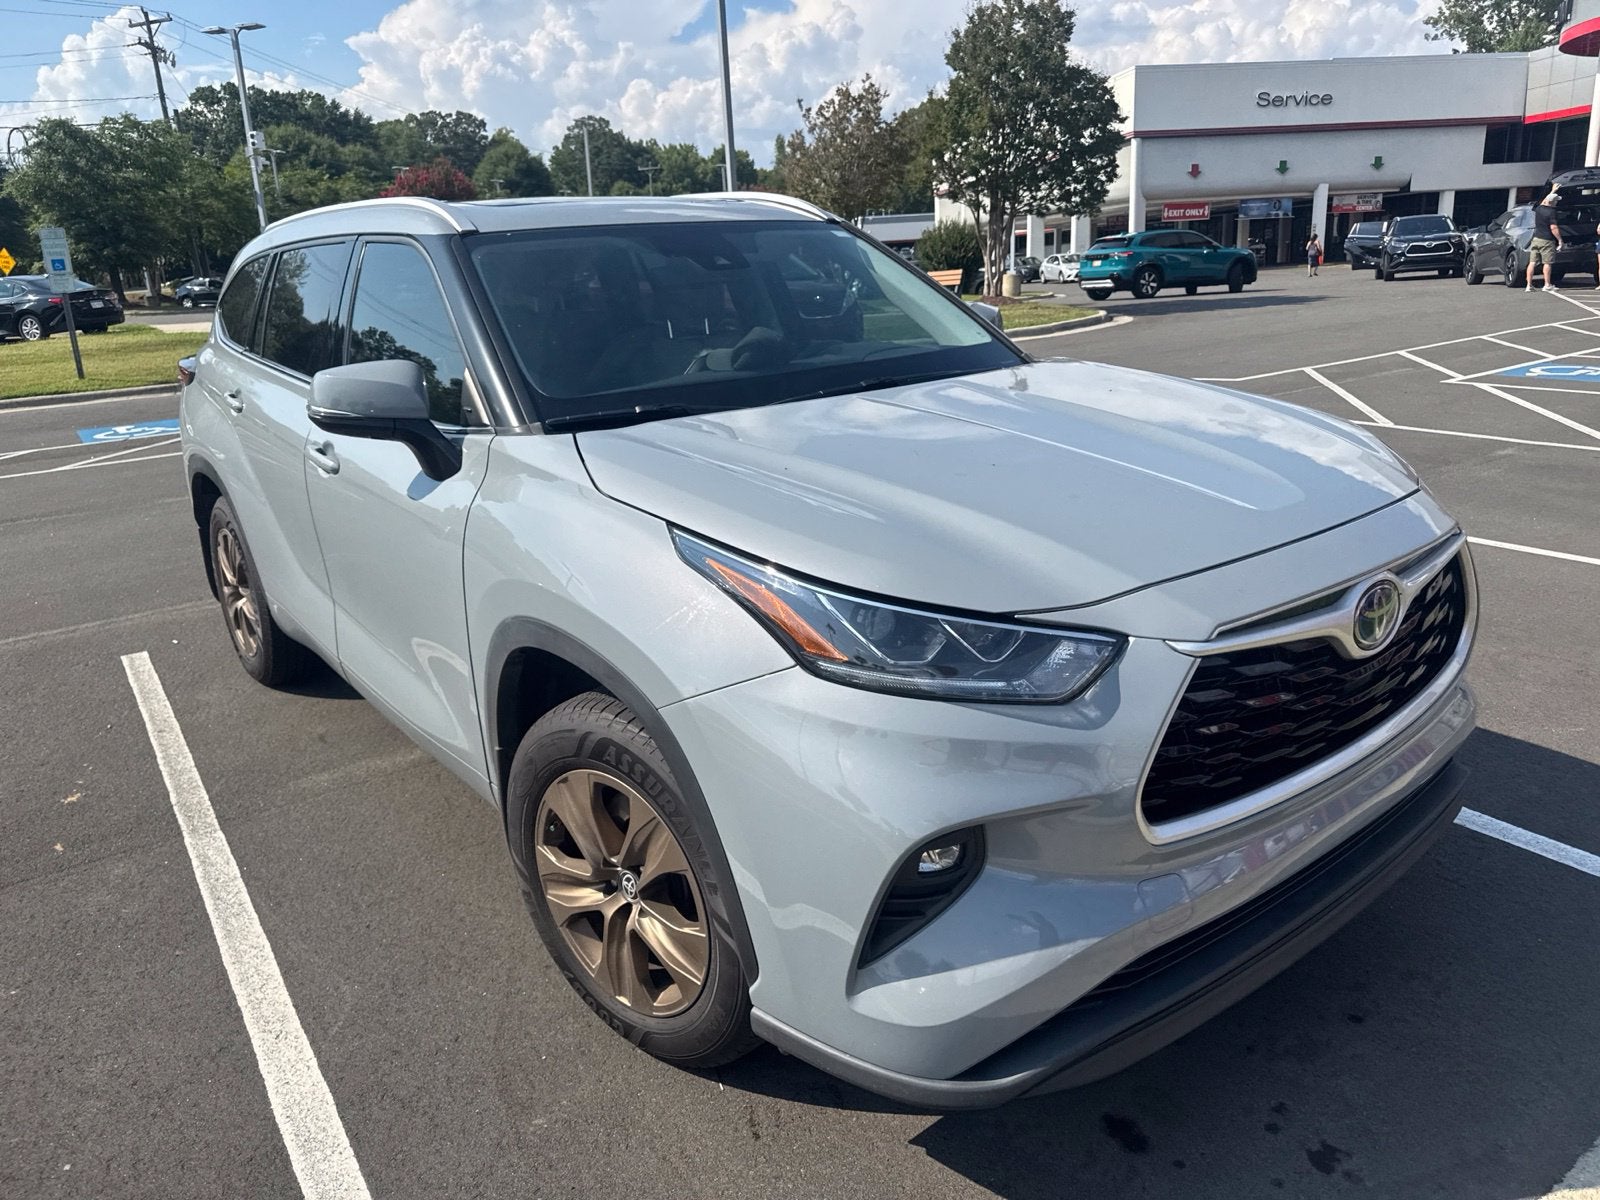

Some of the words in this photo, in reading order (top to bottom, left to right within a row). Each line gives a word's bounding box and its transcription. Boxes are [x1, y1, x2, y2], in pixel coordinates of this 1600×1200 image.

[1256, 91, 1333, 107] Service
[1168, 209, 1184, 217] EXIT
[1185, 208, 1204, 216] ONLY
